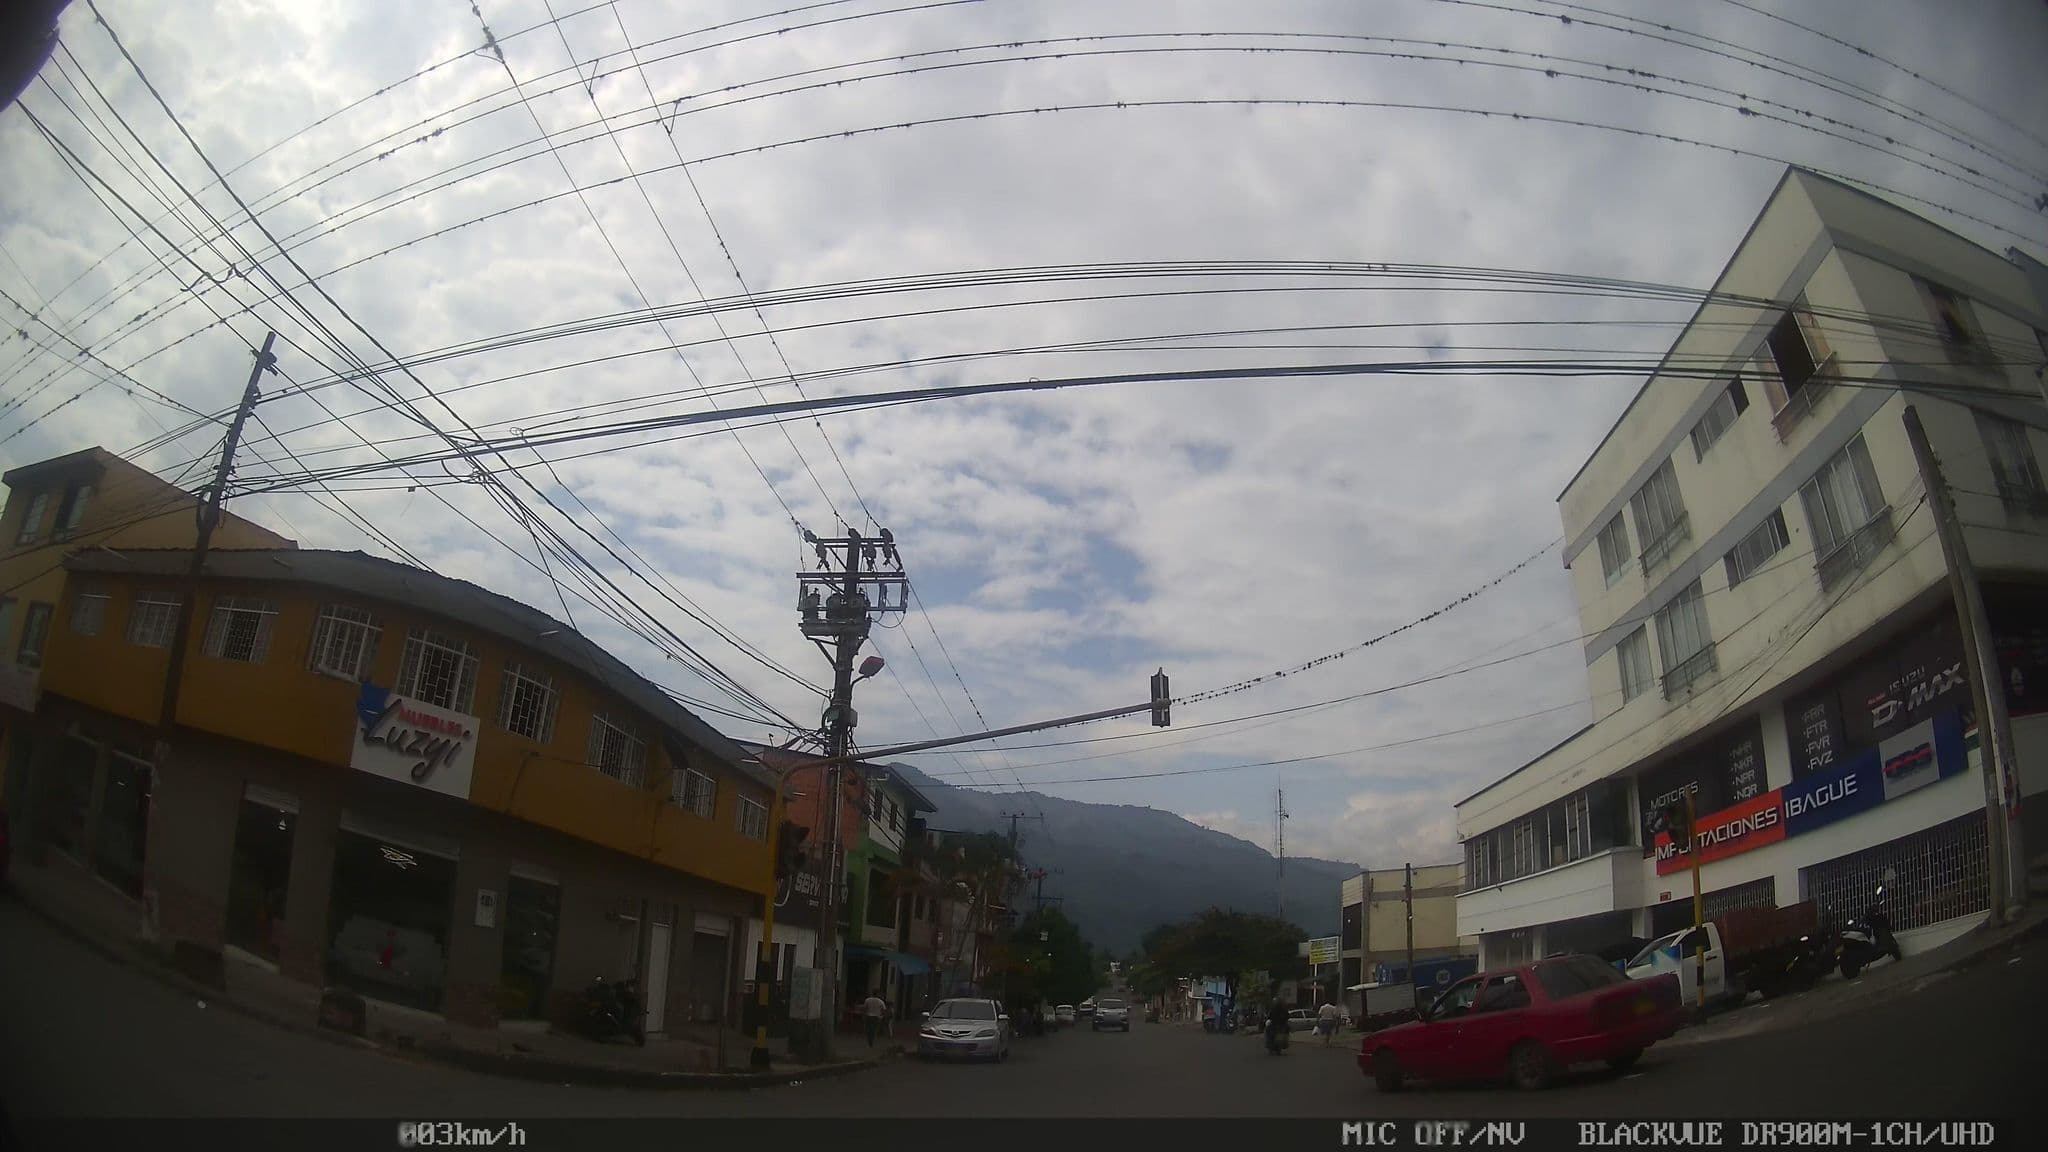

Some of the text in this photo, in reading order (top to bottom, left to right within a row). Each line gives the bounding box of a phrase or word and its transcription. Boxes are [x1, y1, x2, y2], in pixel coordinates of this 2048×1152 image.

[1872, 661, 1967, 729] D-MAX
[1806, 720, 1828, 739] FTR
[1808, 735, 1831, 755] FVR
[1809, 750, 1834, 770] FVZ
[1655, 774, 1858, 861] IMPTACIONES IBAGUE
